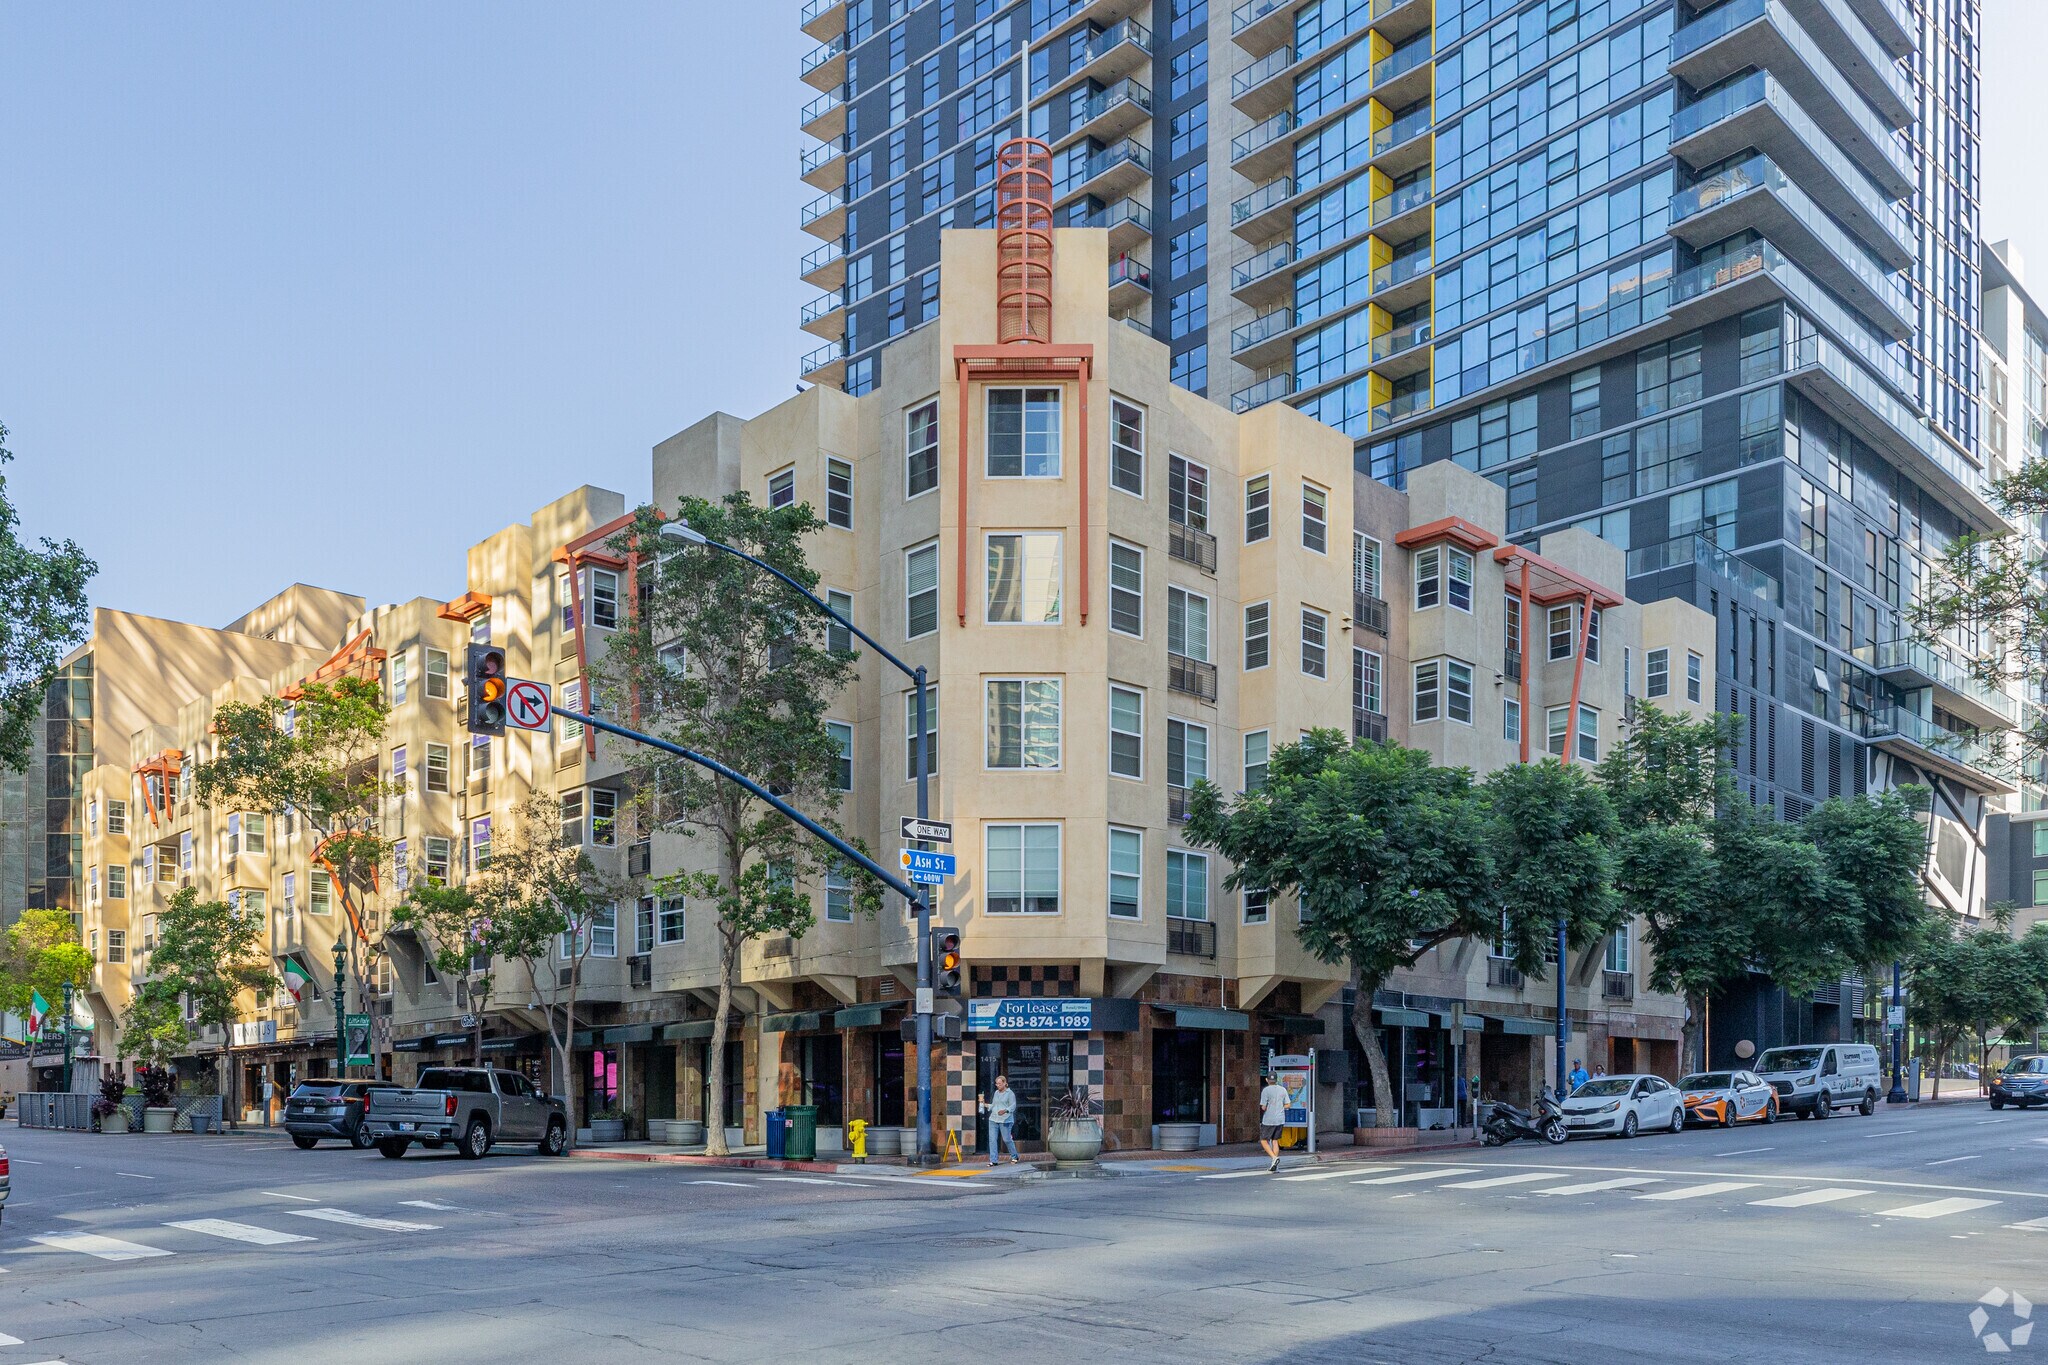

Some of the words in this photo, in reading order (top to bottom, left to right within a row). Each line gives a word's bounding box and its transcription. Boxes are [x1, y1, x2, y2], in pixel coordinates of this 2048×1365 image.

[917, 825, 931, 835] ONE
[933, 827, 948, 837] WAY
[915, 855, 931, 868] ASH
[935, 857, 947, 870] ST.
[923, 874, 941, 882] 600W
[1006, 1003, 1024, 1013] For
[1027, 1003, 1058, 1013] Lease
[999, 1016, 1090, 1027] 858-874-1989
[237, 1025, 270, 1037] VNARUS
